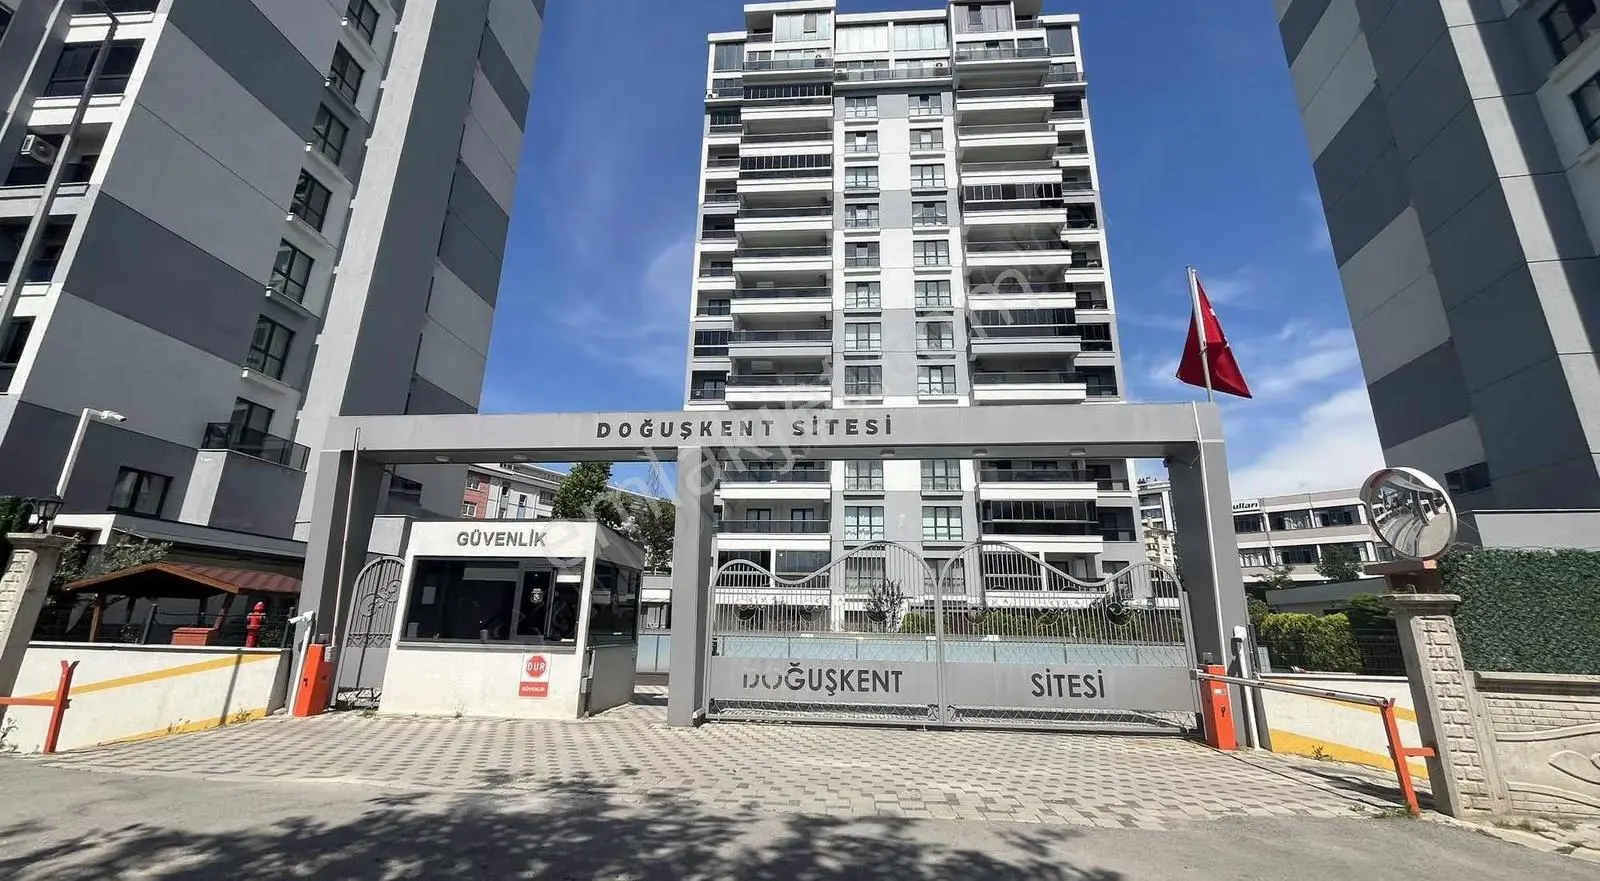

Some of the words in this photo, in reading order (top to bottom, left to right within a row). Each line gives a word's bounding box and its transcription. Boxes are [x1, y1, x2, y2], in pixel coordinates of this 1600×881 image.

[596, 418, 774, 440] DOĞUŞKENT
[792, 414, 892, 436] SİTESİ
[456, 529, 547, 547] GÜVENLİK
[527, 662, 546, 672] DUR
[1031, 668, 1105, 698] SİTESİ
